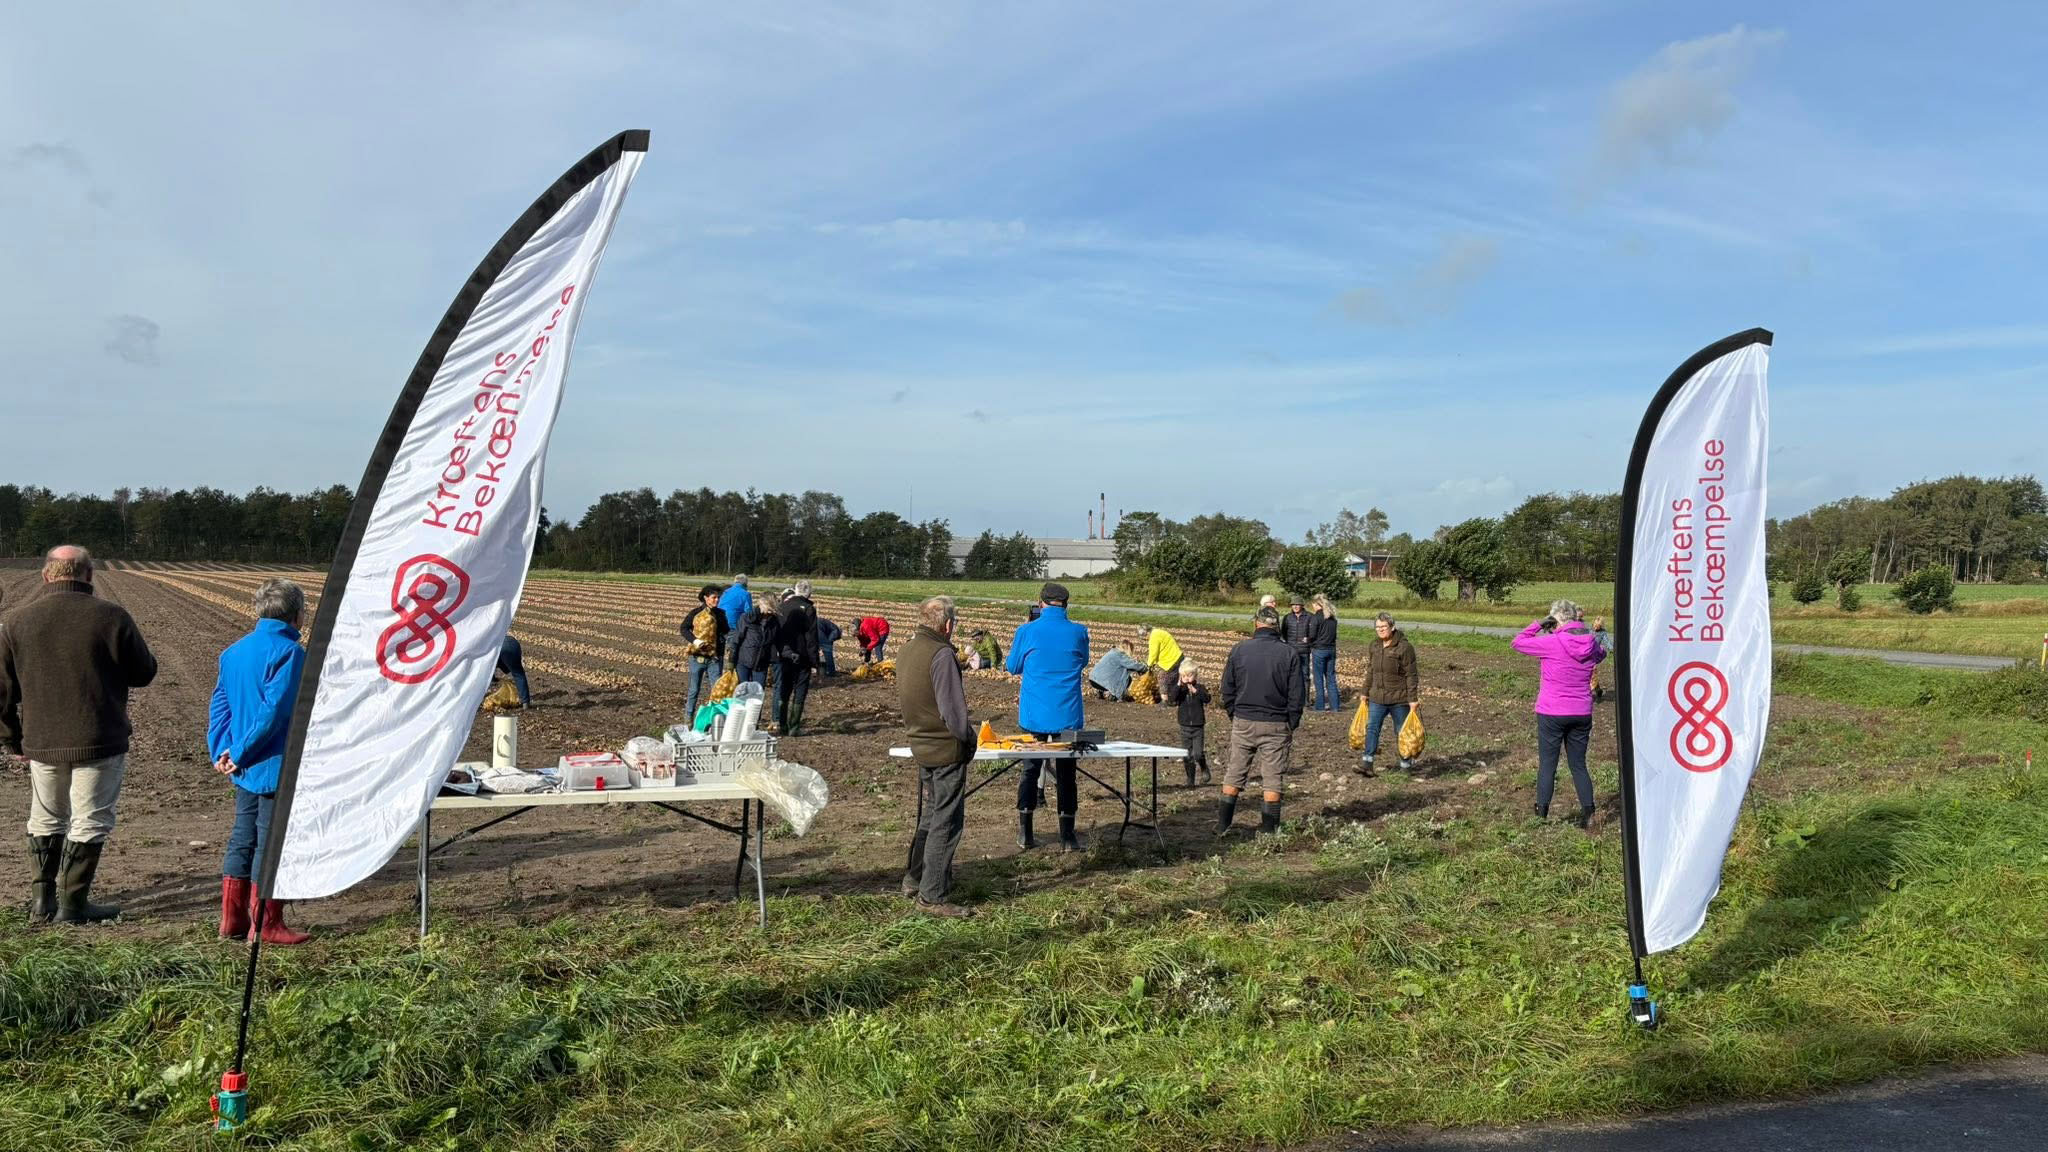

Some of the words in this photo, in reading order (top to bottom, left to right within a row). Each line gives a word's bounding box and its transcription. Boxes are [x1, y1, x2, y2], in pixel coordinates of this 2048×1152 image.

[422, 351, 517, 529] Kræftens
[1667, 497, 1695, 643] Kræftens
[1699, 438, 1731, 643] Bekæmpelse
